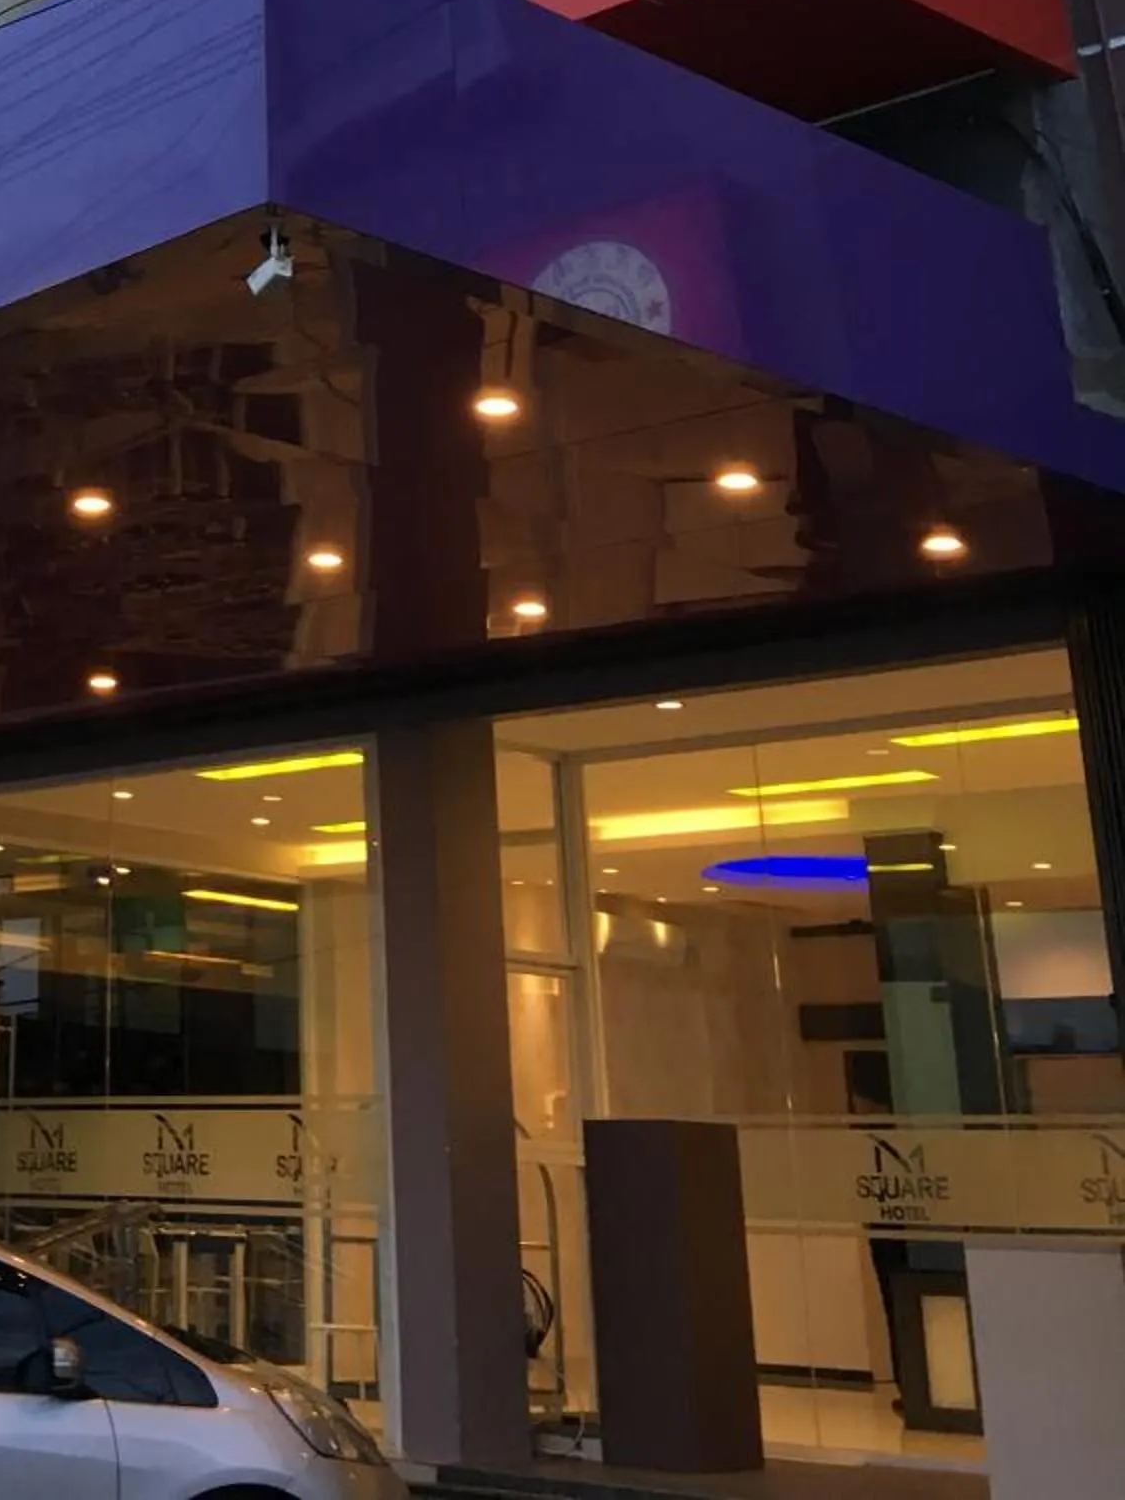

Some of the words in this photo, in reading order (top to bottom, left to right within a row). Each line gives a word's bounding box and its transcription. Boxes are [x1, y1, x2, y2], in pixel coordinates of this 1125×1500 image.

[16, 1150, 78, 1174] SQUARE
[142, 1152, 211, 1178] SQUARE
[855, 1175, 950, 1203] SQUARE
[880, 1205, 931, 1221] HOTEL
